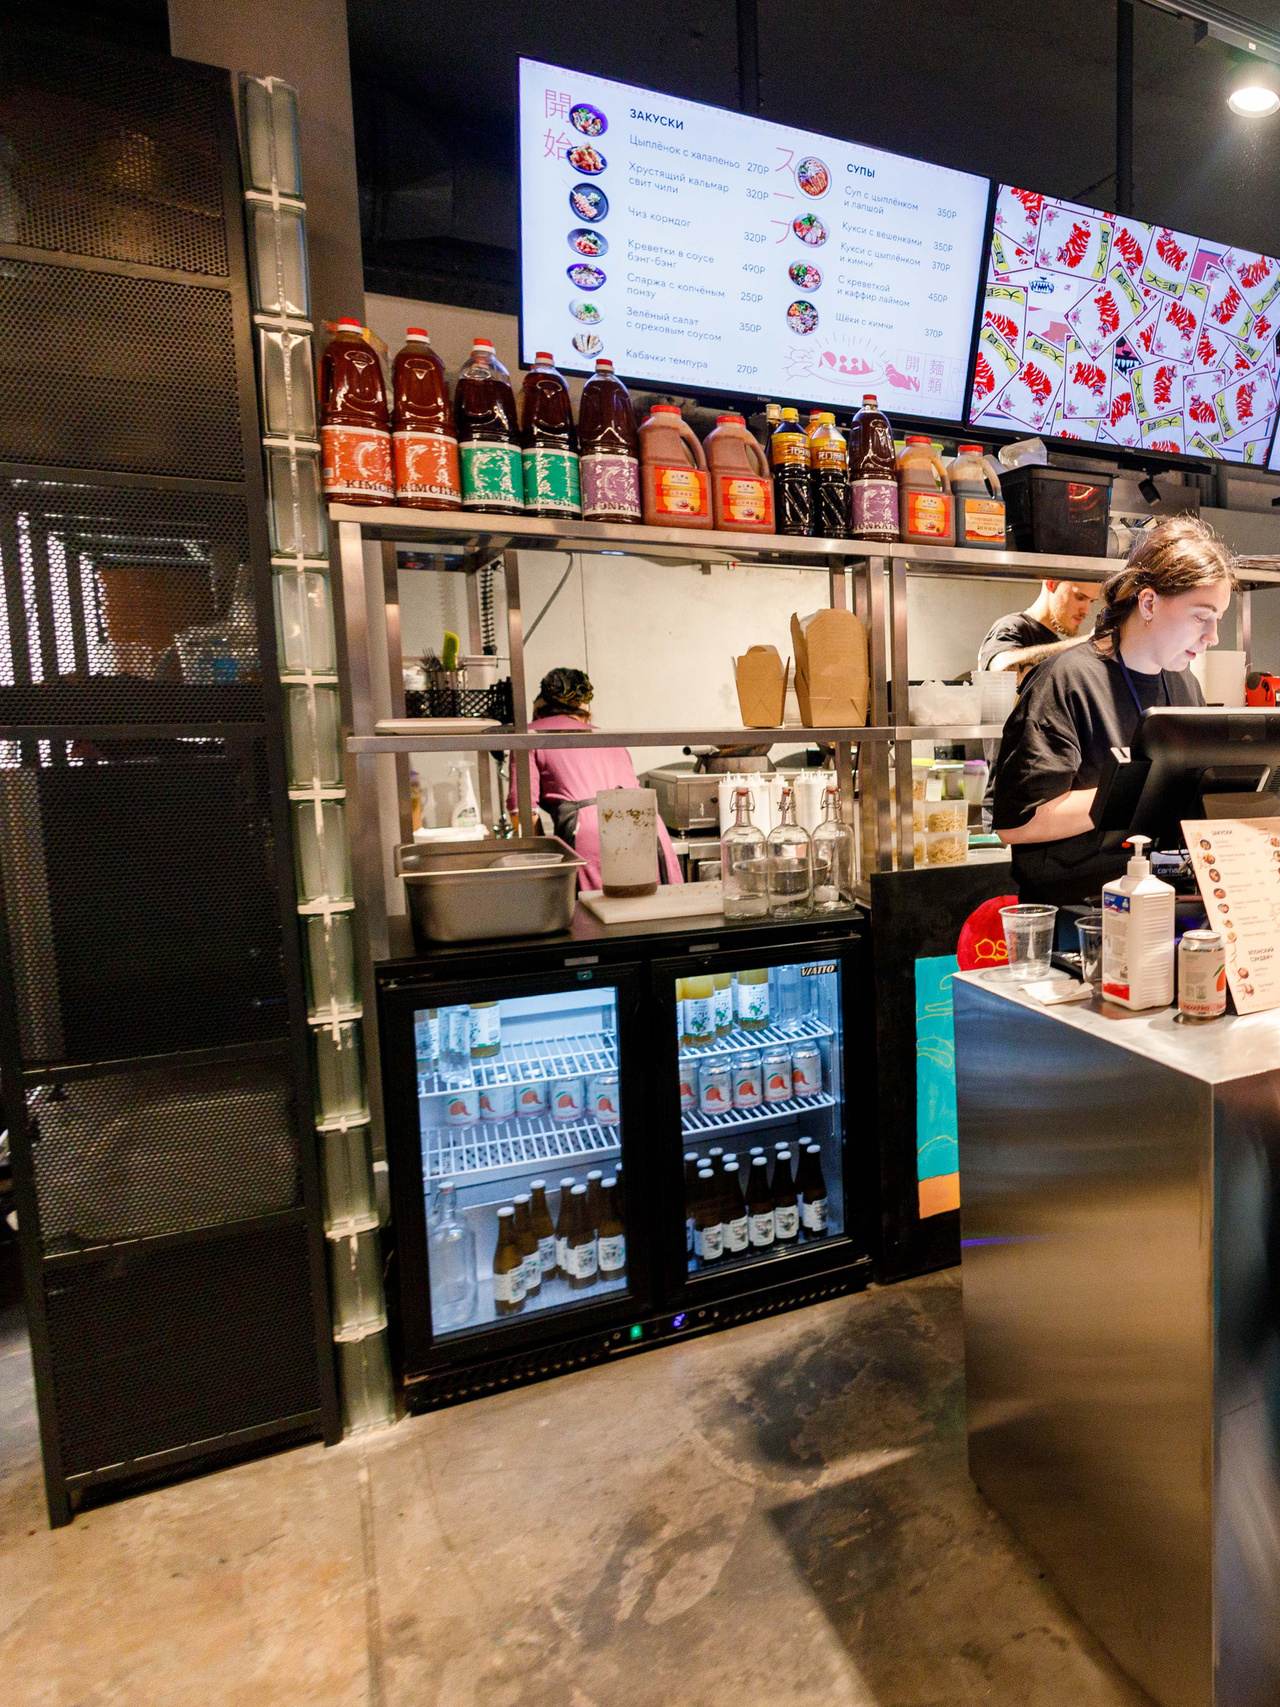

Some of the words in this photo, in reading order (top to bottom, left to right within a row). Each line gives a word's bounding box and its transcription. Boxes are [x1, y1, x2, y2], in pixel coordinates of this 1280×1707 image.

[629, 108, 684, 130] ЗАКУСКИ
[629, 134, 681, 156] Цыплёнок
[683, 149, 689, 157] с
[691, 151, 740, 169] халапеньо
[628, 161, 686, 183] Хрустящий
[688, 177, 730, 193] кальмар
[846, 163, 876, 178] СУПЫ
[628, 177, 652, 188] свит
[654, 182, 679, 194] чили
[844, 185, 862, 199] Суп
[871, 193, 919, 211] цыплёнком
[853, 201, 885, 215] лапшой
[628, 206, 648, 219] Чиз
[650, 212, 692, 228] корндог
[842, 220, 867, 235] Кукси
[876, 229, 923, 247] вешенками
[627, 238, 675, 257] Креветки
[686, 252, 714, 264] соусе
[627, 252, 677, 269] бэнг-бэнг
[840, 241, 865, 256] Кукси
[874, 249, 921, 267] цыплёнком
[847, 257, 874, 268] кимчи
[627, 272, 666, 290] Спаржа
[677, 282, 725, 298] копчёным
[627, 287, 656, 300] понзу
[847, 277, 890, 293] креветкой
[844, 288, 877, 303] каффир
[879, 295, 910, 308] лаймом
[626, 306, 670, 322] Зелёный
[673, 314, 699, 326] салат
[835, 312, 860, 325] Щёки
[868, 320, 894, 330] кимчи
[635, 322, 685, 337] ореховым
[687, 329, 722, 342] соусом
[626, 348, 666, 364] Кабачки
[669, 356, 708, 370] темпура
